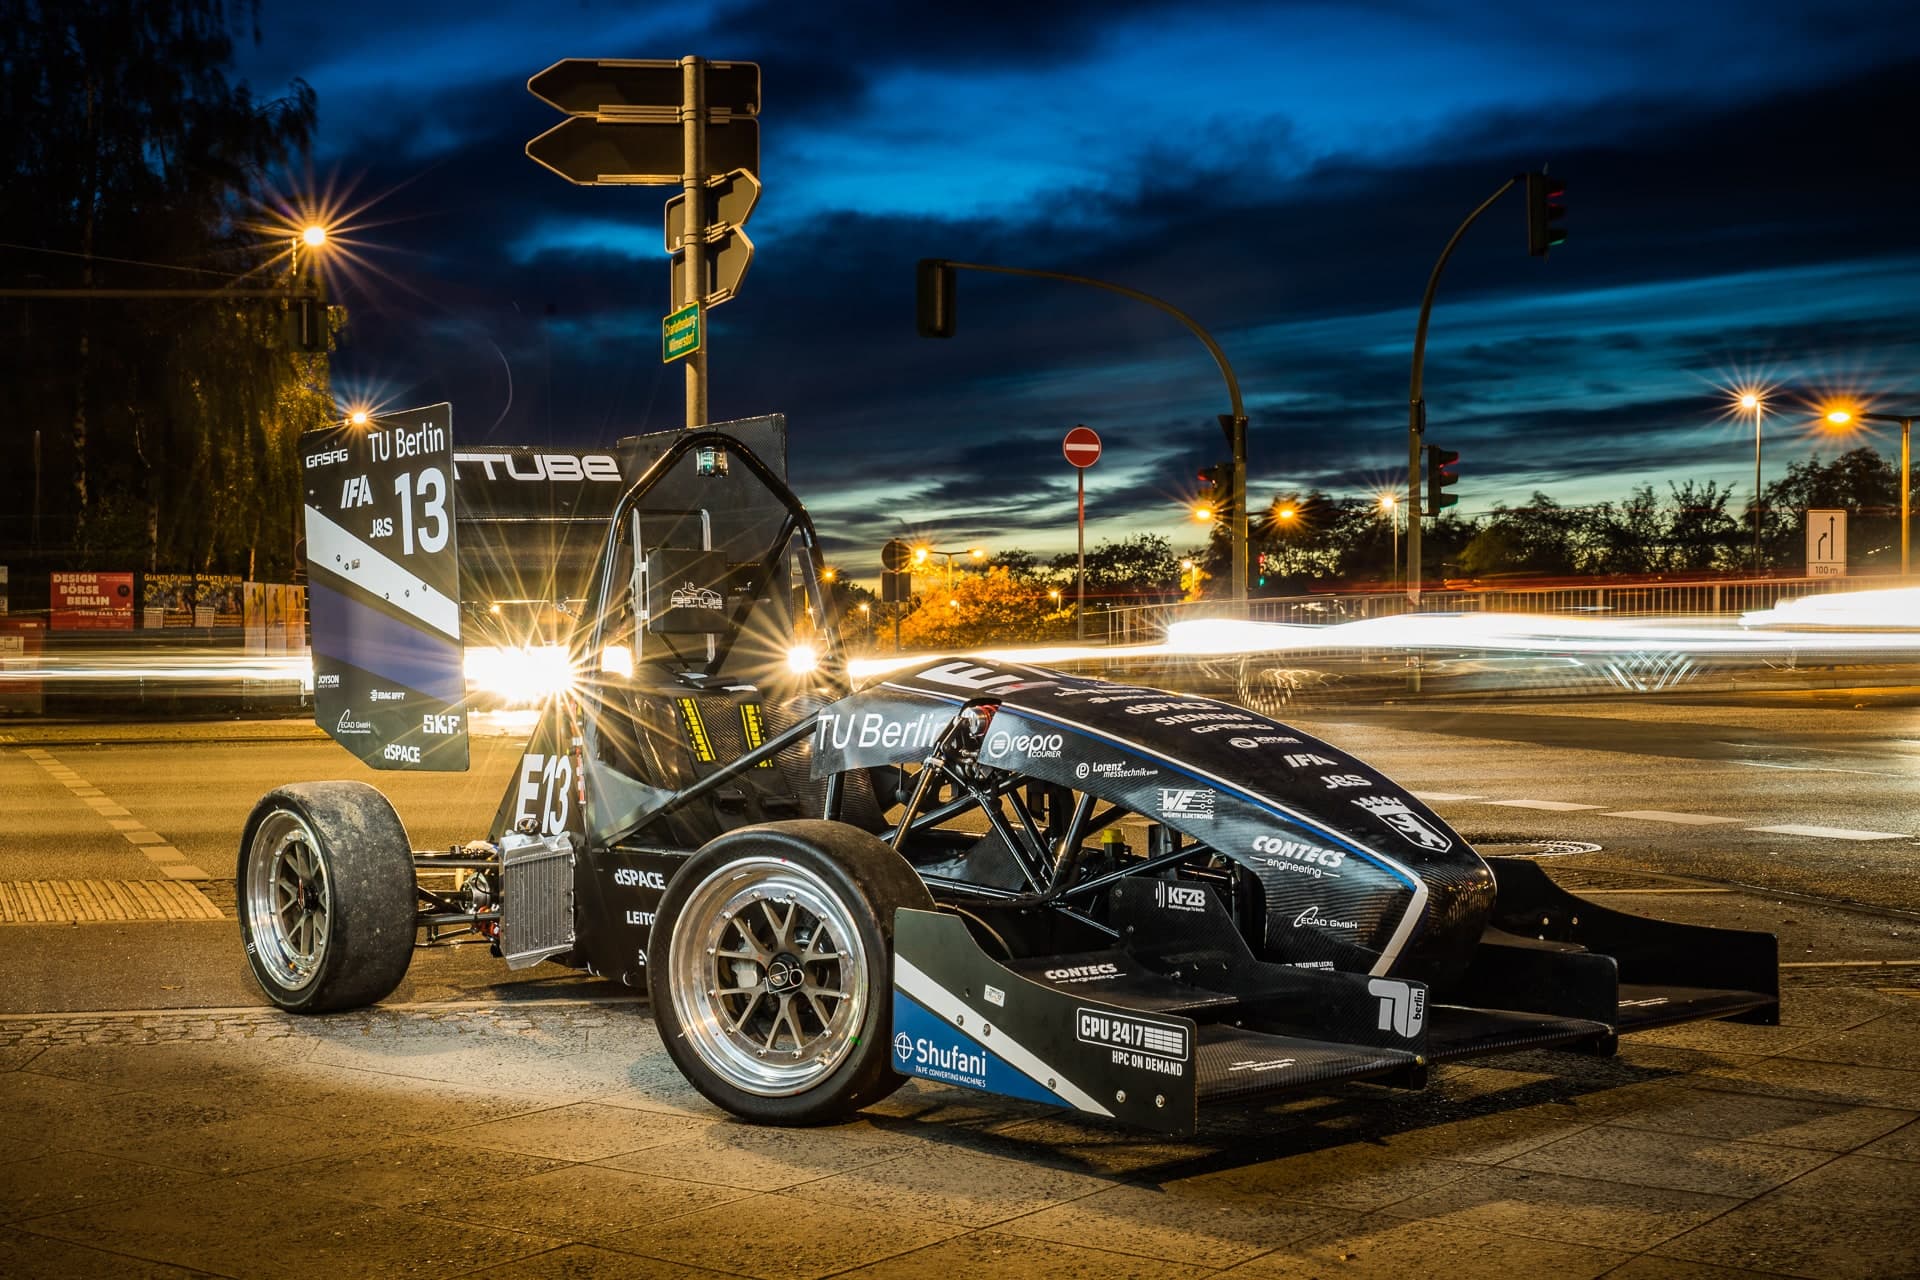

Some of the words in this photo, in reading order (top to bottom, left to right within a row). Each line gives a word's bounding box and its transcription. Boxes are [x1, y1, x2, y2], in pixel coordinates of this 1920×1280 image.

[368, 431, 390, 463] TU
[396, 422, 445, 458] Berlin
[306, 449, 349, 469] GASAG
[340, 474, 374, 510] IFA
[394, 467, 449, 555] 13
[369, 517, 393, 539] J&S
[53, 574, 97, 583] DESIGN
[1815, 566, 1829, 574] 100
[60, 583, 99, 594] BÖRSE
[66, 596, 110, 605] BERLIN
[423, 714, 461, 734] SKF
[818, 715, 854, 750] TU
[384, 743, 420, 763] dSPACE
[1010, 734, 1063, 758] repro
[1031, 750, 1062, 758] COURIER
[1092, 761, 1122, 772] Lorenz
[1103, 768, 1146, 778] messtechnik
[1321, 774, 1373, 789] J&S
[1252, 836, 1347, 868] CONTECS
[614, 869, 667, 889] dSPACE
[1267, 859, 1322, 879] engineering
[1168, 886, 1206, 907] KFZB
[1044, 963, 1118, 979] CONTECS
[1412, 990, 1424, 1021] berlin
[1081, 1015, 1109, 1040] CPU
[916, 1038, 986, 1076] Shufani
[1112, 1050, 1130, 1066] HPC
[1131, 1054, 1143, 1069] ON
[1145, 1057, 1183, 1077] DEMAND
[915, 1065, 928, 1074] TAPE
[929, 1068, 959, 1081] CONVERTING
[959, 1075, 986, 1088] MACHINES
